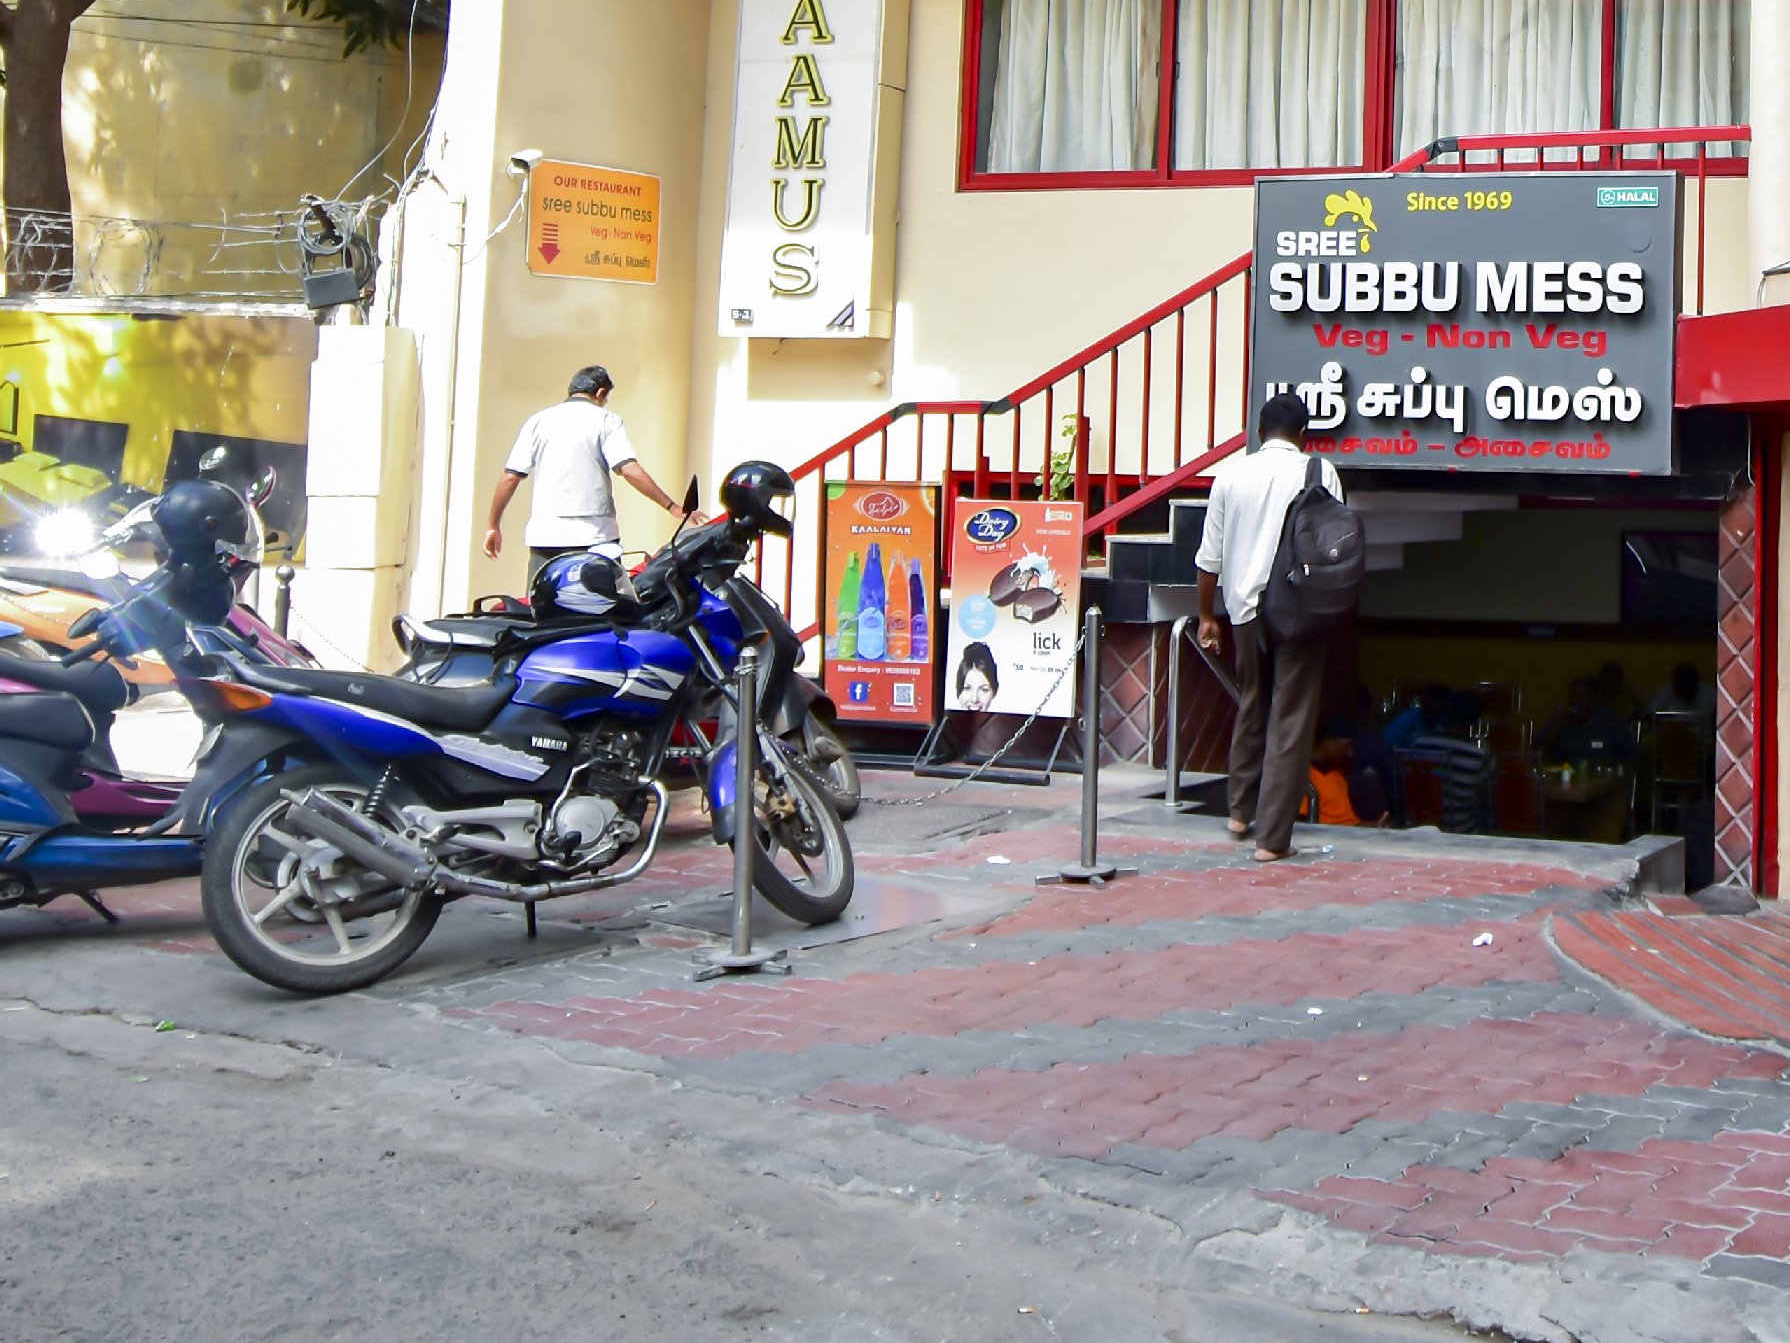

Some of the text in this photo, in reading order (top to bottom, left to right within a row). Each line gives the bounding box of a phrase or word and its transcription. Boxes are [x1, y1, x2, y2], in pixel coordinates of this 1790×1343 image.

[554, 176, 642, 197] OUR RESTAURANT
[1616, 191, 1656, 202] HALAL
[542, 197, 652, 222] sree subbu mess
[1406, 191, 1512, 212] Since 1969
[590, 226, 608, 239] Veg
[613, 228, 632, 240] Non
[635, 230, 652, 244] Veg
[1275, 230, 1358, 257] SREE
[1268, 261, 1646, 316] SUBBU MESS
[1312, 323, 1390, 355] Veg
[1425, 323, 1512, 349] Non
[1526, 323, 1608, 357] Veg
[1356, 366, 1465, 433] சுப்பு
[1485, 367, 1644, 423] மெஸ்
[974, 511, 1009, 530] Dairy
[977, 524, 1005, 542] Day
[1033, 632, 1061, 650] lick
[531, 735, 568, 752] YAMAHA
